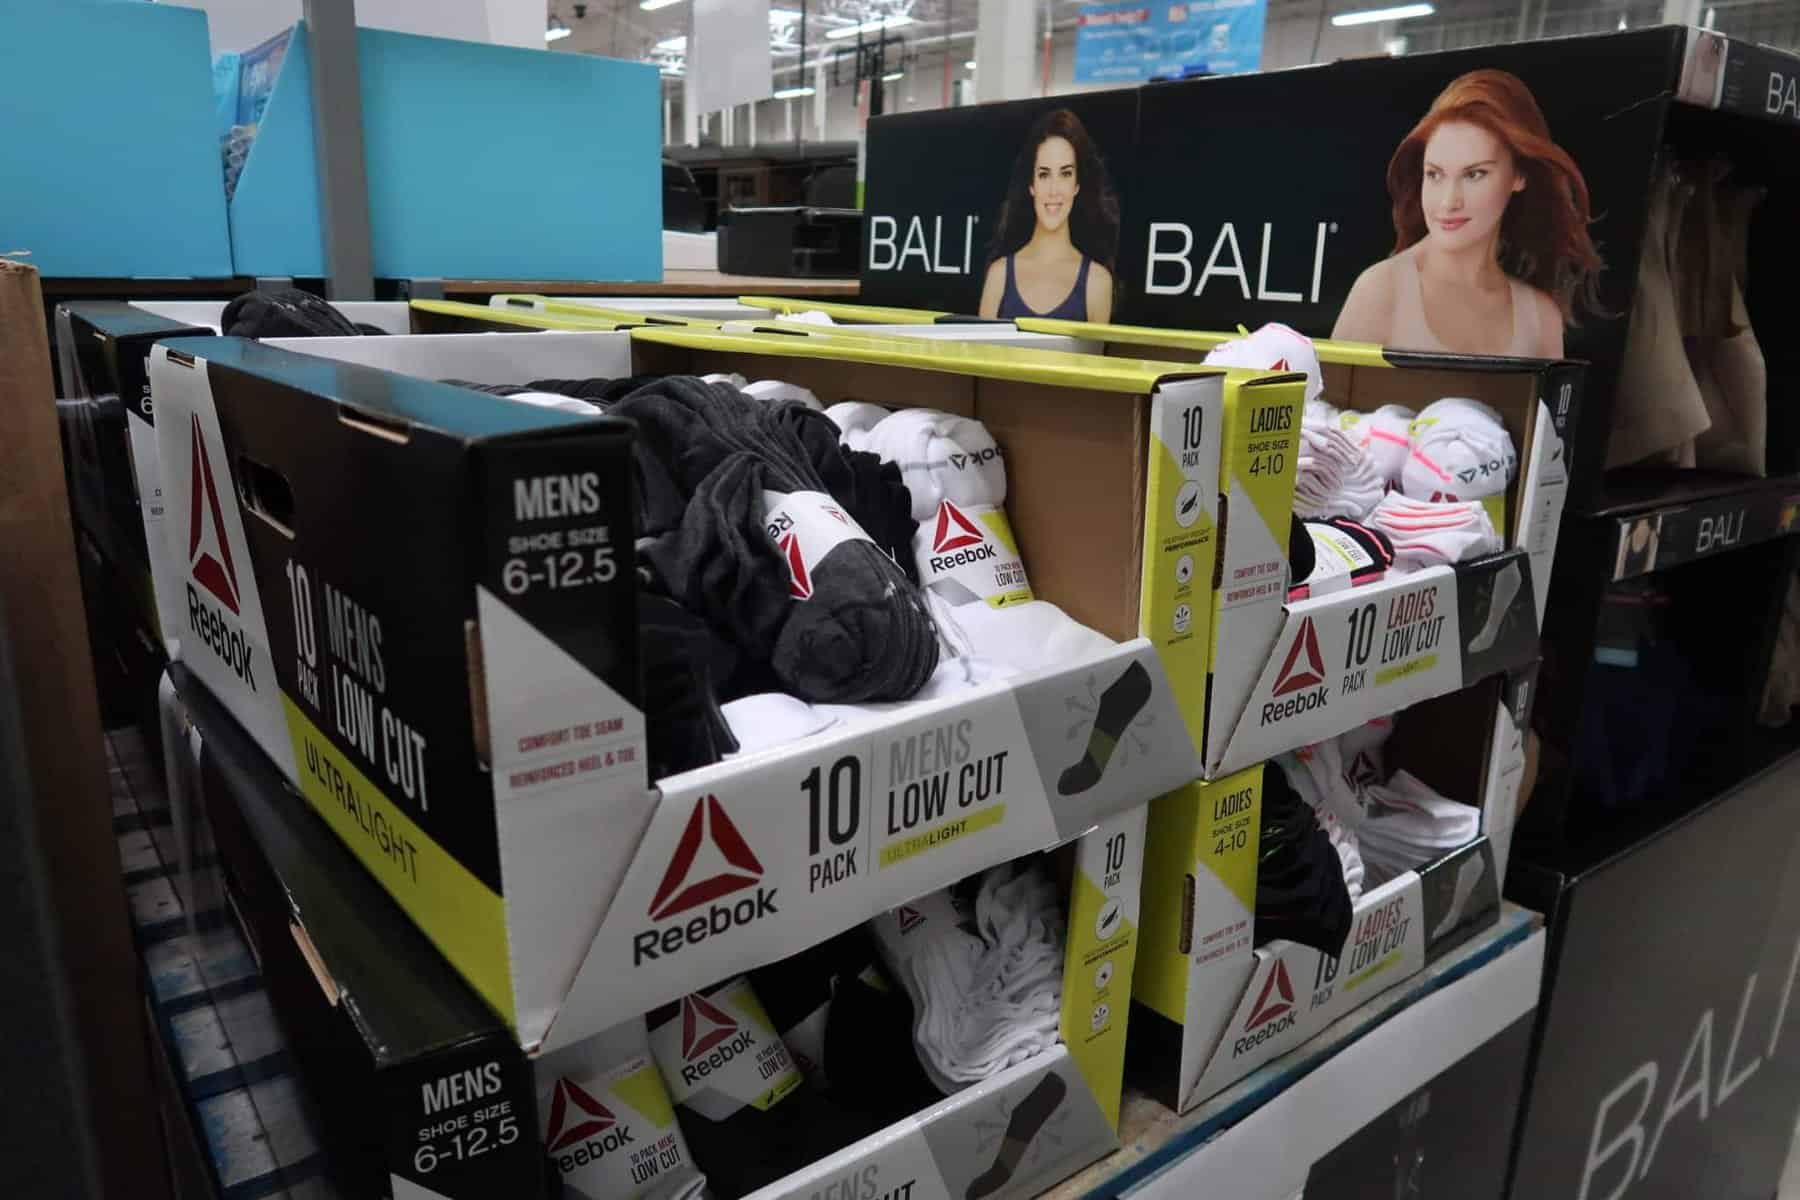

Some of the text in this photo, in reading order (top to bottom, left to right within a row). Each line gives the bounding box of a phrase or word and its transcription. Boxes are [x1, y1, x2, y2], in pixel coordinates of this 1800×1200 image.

[1766, 71, 1800, 119] BA
[869, 215, 973, 275] BALI
[1145, 222, 1327, 303] BALI
[1182, 406, 1203, 450] 10
[1250, 405, 1293, 434] LADIES
[1182, 452, 1200, 467] PACK
[1247, 438, 1289, 454] SHOE SIZE
[1249, 454, 1284, 476] 4-10
[514, 471, 600, 521] MENS
[508, 525, 609, 554] SHOE SIZE
[1696, 510, 1746, 553] BALI
[502, 547, 617, 595] 6-12.5
[930, 543, 998, 574] Reebok
[286, 558, 317, 669] 10
[1387, 586, 1438, 630] LADIES
[186, 581, 257, 693] Reebok
[324, 582, 386, 694] MENS
[1345, 603, 1377, 669] 10
[1381, 616, 1445, 664] LOW CUT
[297, 658, 321, 713] PACK
[1260, 686, 1330, 727] Reebok
[1342, 670, 1367, 697] PACK
[332, 663, 429, 812] LOW CUT
[889, 719, 973, 787] MENS
[304, 735, 418, 885] ULTRALIGHT
[800, 755, 861, 857] 10
[887, 751, 1008, 836] LOW CUT
[1215, 787, 1253, 821] LADIES
[887, 820, 967, 861] ULTRALIGHT
[1104, 832, 1126, 874] 10
[1214, 830, 1247, 856] 4-10
[809, 847, 857, 893] PACK
[1104, 871, 1121, 889] PACK
[633, 888, 779, 967] Reebok
[1355, 896, 1404, 946] LADIES
[1350, 935, 1383, 975] LOW
[1383, 917, 1411, 954] CUT
[680, 1030, 756, 1087] Reebok
[1232, 1009, 1297, 1060] Reebok
[422, 1062, 502, 1115] MENS
[1577, 930, 1800, 1200] BALI
[414, 1116, 519, 1173] 6-12.5
[418, 1100, 512, 1142] SHOE SIZE
[557, 1124, 635, 1173] eebok
[631, 1144, 681, 1185] LOW CUT
